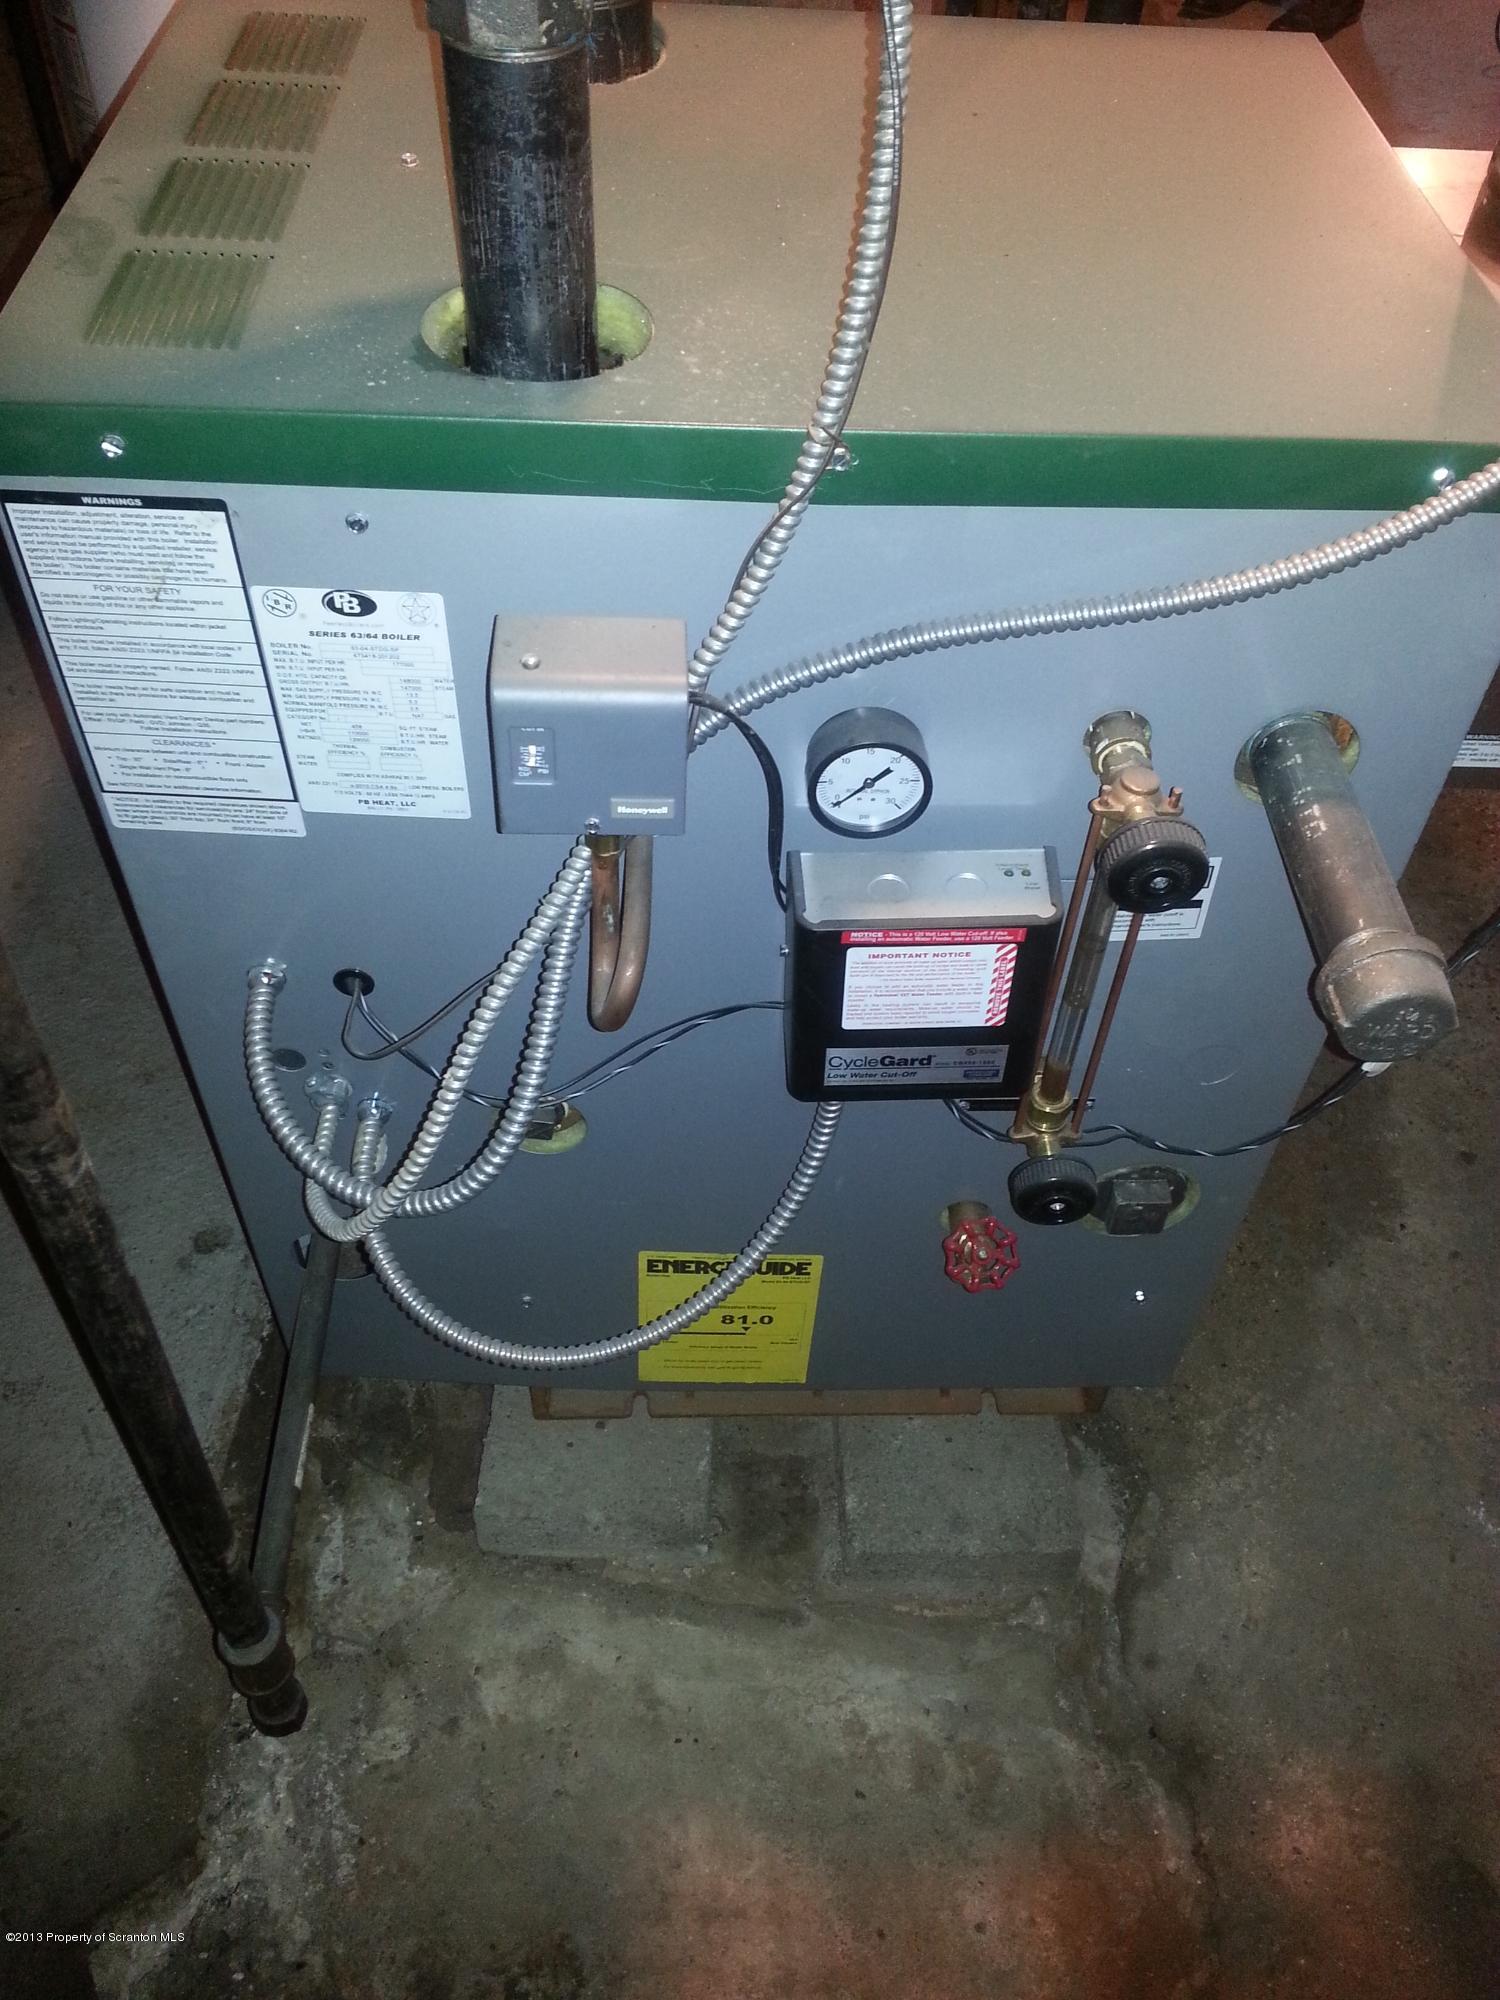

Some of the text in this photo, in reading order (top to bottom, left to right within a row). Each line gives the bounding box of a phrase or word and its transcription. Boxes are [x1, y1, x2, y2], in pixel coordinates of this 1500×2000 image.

[81, 496, 142, 506] WARNINGS
[116, 585, 142, 593] YOUR
[145, 586, 181, 594] SAFETY
[332, 591, 361, 614] PB
[617, 806, 668, 815] Honeywell
[828, 1055, 933, 1070] CycleGard
[721, 1315, 774, 1325] 81.0
